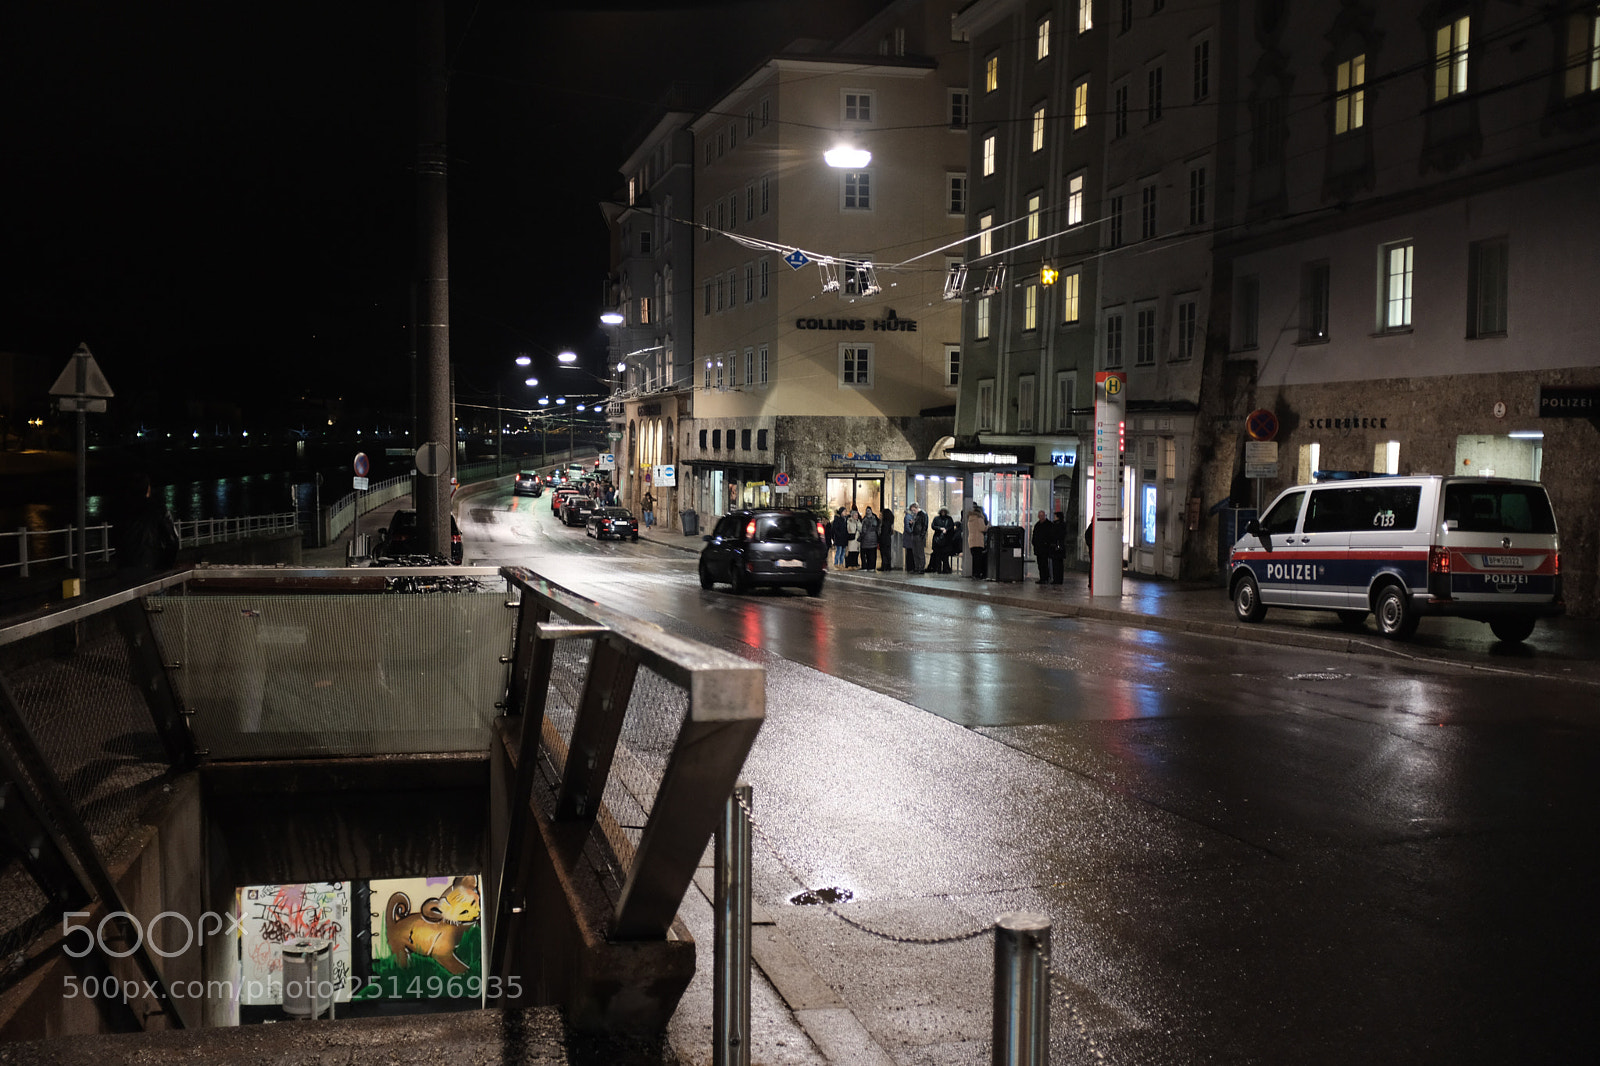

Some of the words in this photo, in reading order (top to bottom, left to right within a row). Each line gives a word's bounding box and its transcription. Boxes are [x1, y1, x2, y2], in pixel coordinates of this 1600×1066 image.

[796, 318, 865, 331] COLLINS
[1542, 397, 1593, 408] POLIZEI
[1380, 512, 1396, 527] 133
[1267, 563, 1317, 581] POLIZEI
[1484, 574, 1529, 585] POLIZEI
